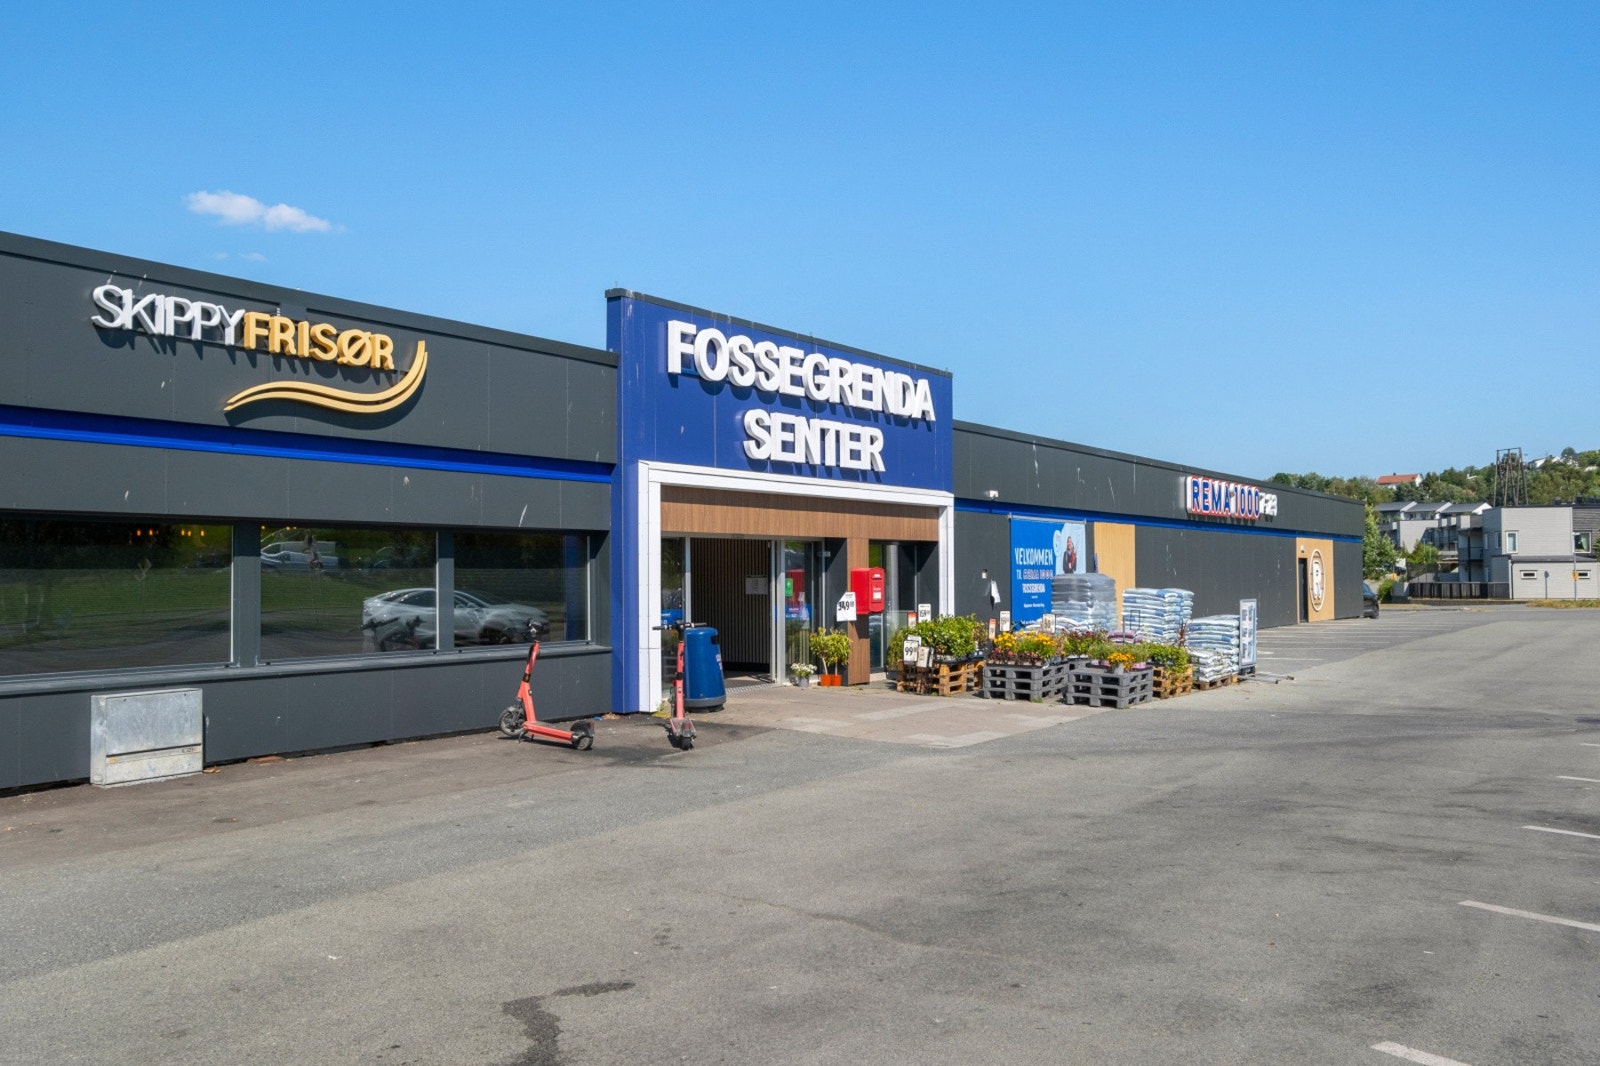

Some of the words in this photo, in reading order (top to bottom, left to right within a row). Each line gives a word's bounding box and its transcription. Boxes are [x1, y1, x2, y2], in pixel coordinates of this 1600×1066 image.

[667, 319, 936, 422] FOSSEGRENDA
[743, 408, 886, 472] SENTER
[1186, 475, 1232, 517] REMA
[1229, 481, 1260, 520] 1000
[1014, 547, 1054, 566] VELKOMMEN
